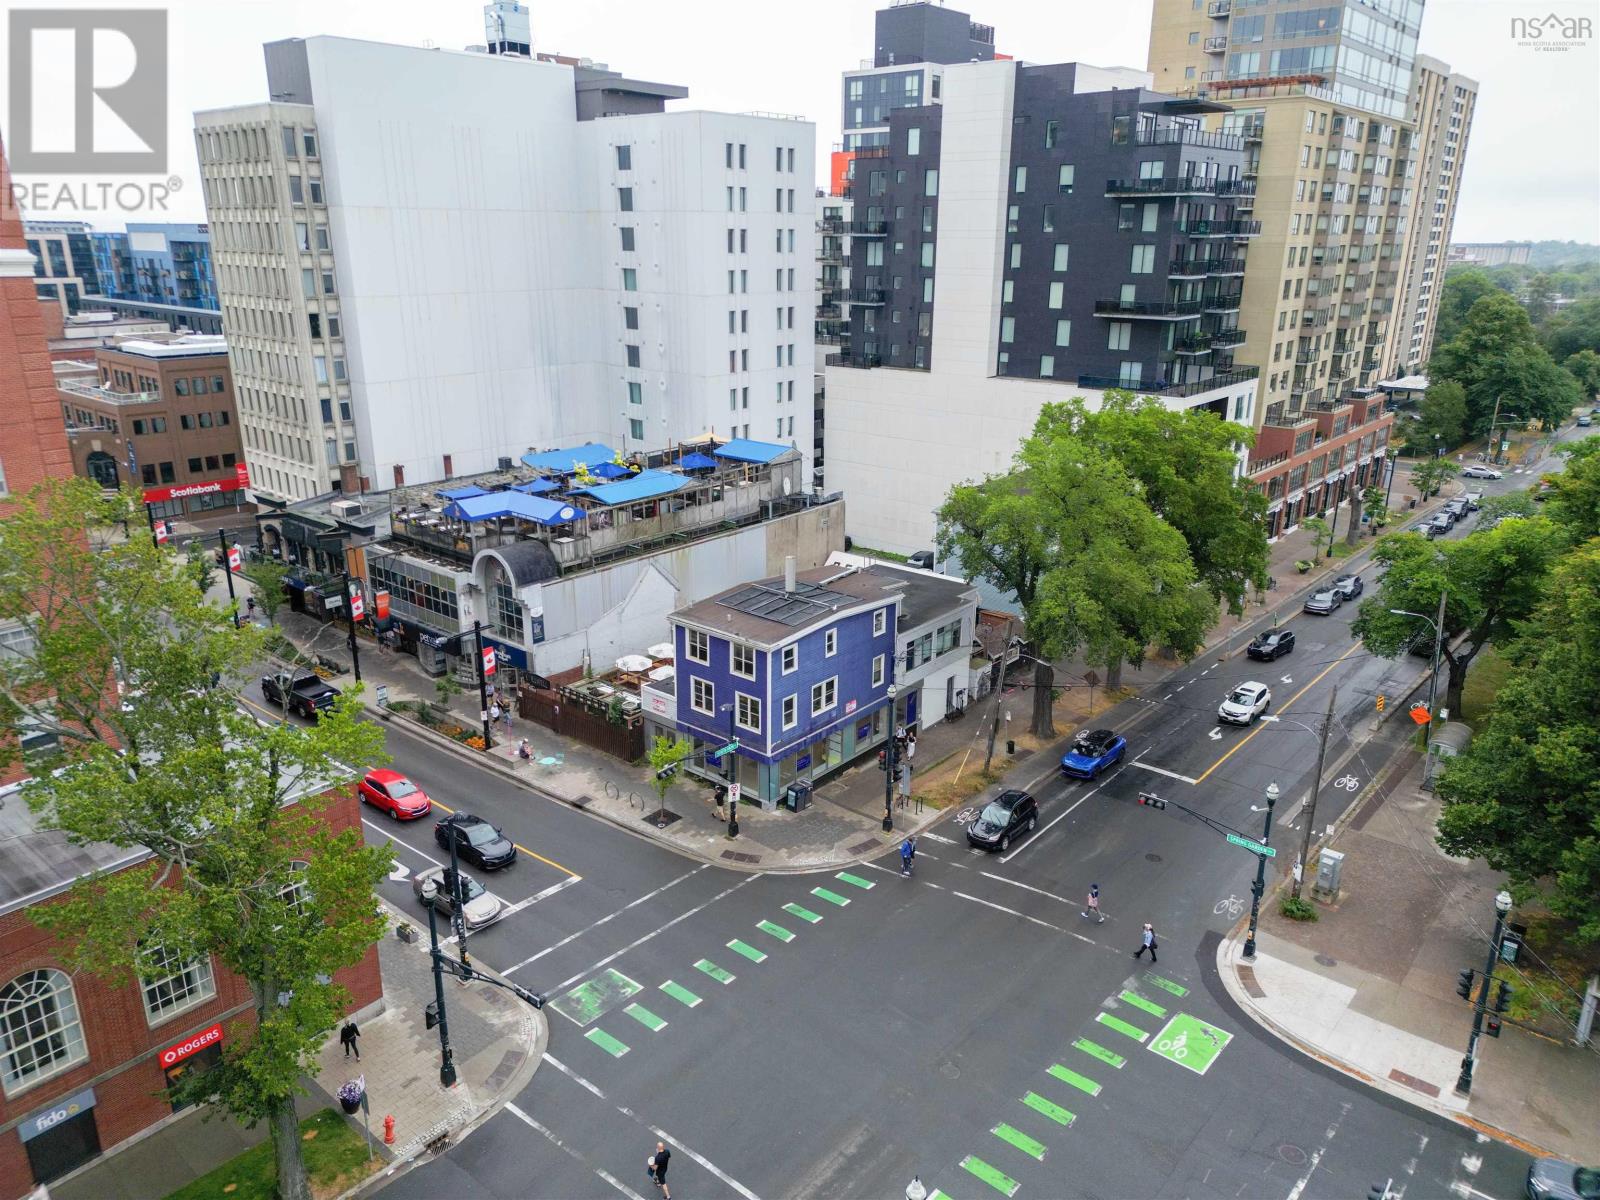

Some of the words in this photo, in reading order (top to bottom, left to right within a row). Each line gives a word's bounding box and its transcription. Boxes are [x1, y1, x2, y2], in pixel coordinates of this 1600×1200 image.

[169, 482, 222, 498] Scotiabank
[1230, 836, 1247, 846] SPRING
[1247, 842, 1268, 853] GARDEN
[177, 1029, 219, 1056] ROGERS
[36, 1110, 67, 1131] fido
